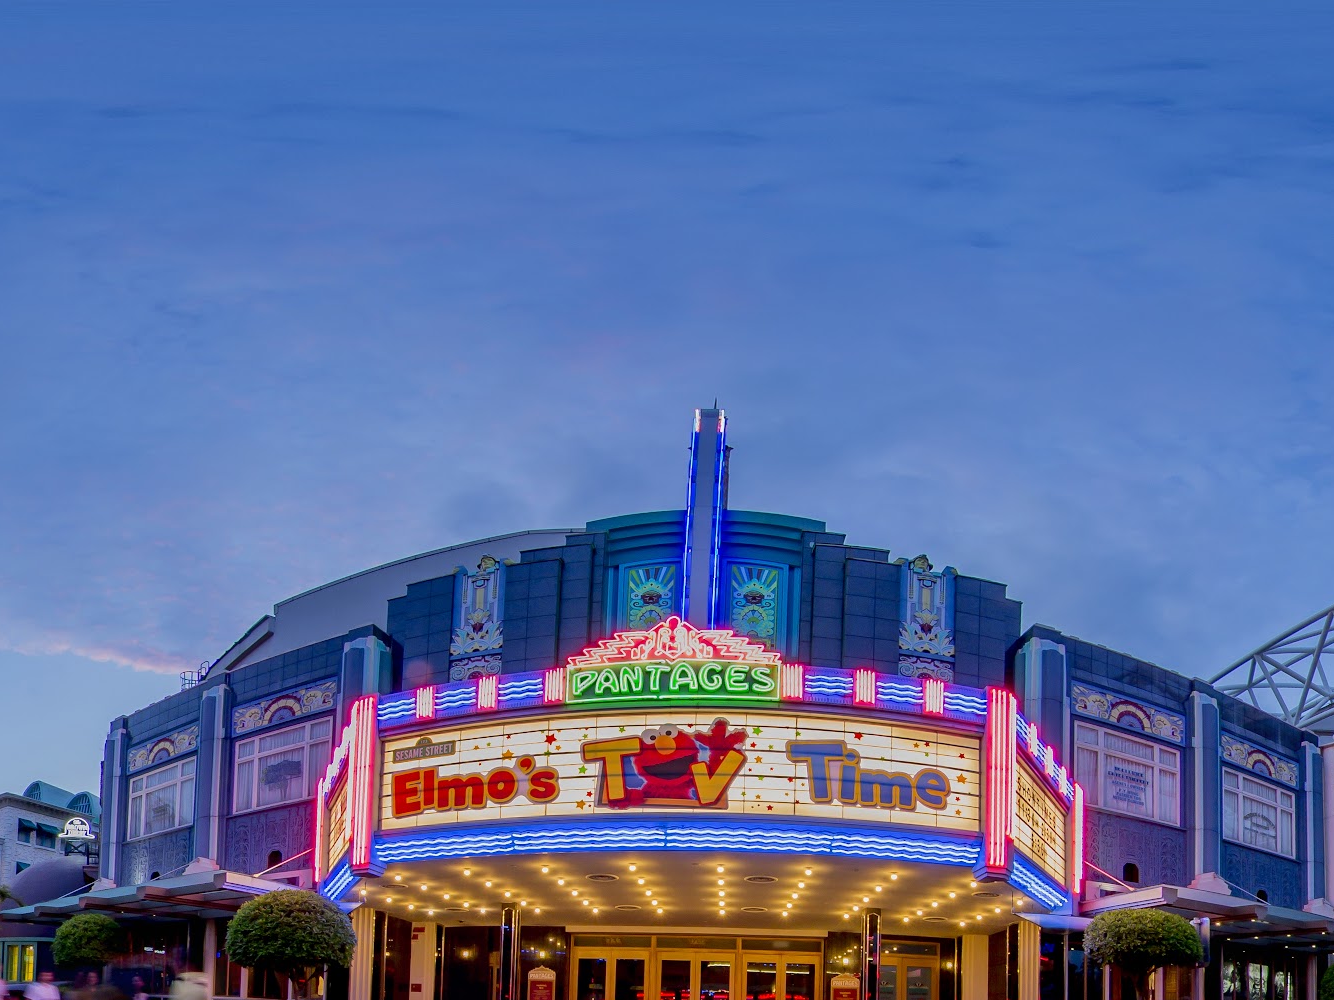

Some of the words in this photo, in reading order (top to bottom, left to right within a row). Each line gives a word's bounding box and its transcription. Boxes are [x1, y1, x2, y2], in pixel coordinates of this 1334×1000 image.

[572, 662, 775, 696] PANTAGES
[395, 746, 424, 761] SESAME
[425, 743, 453, 757] STREET
[394, 756, 558, 816] Elmo's
[788, 741, 948, 809] Time
